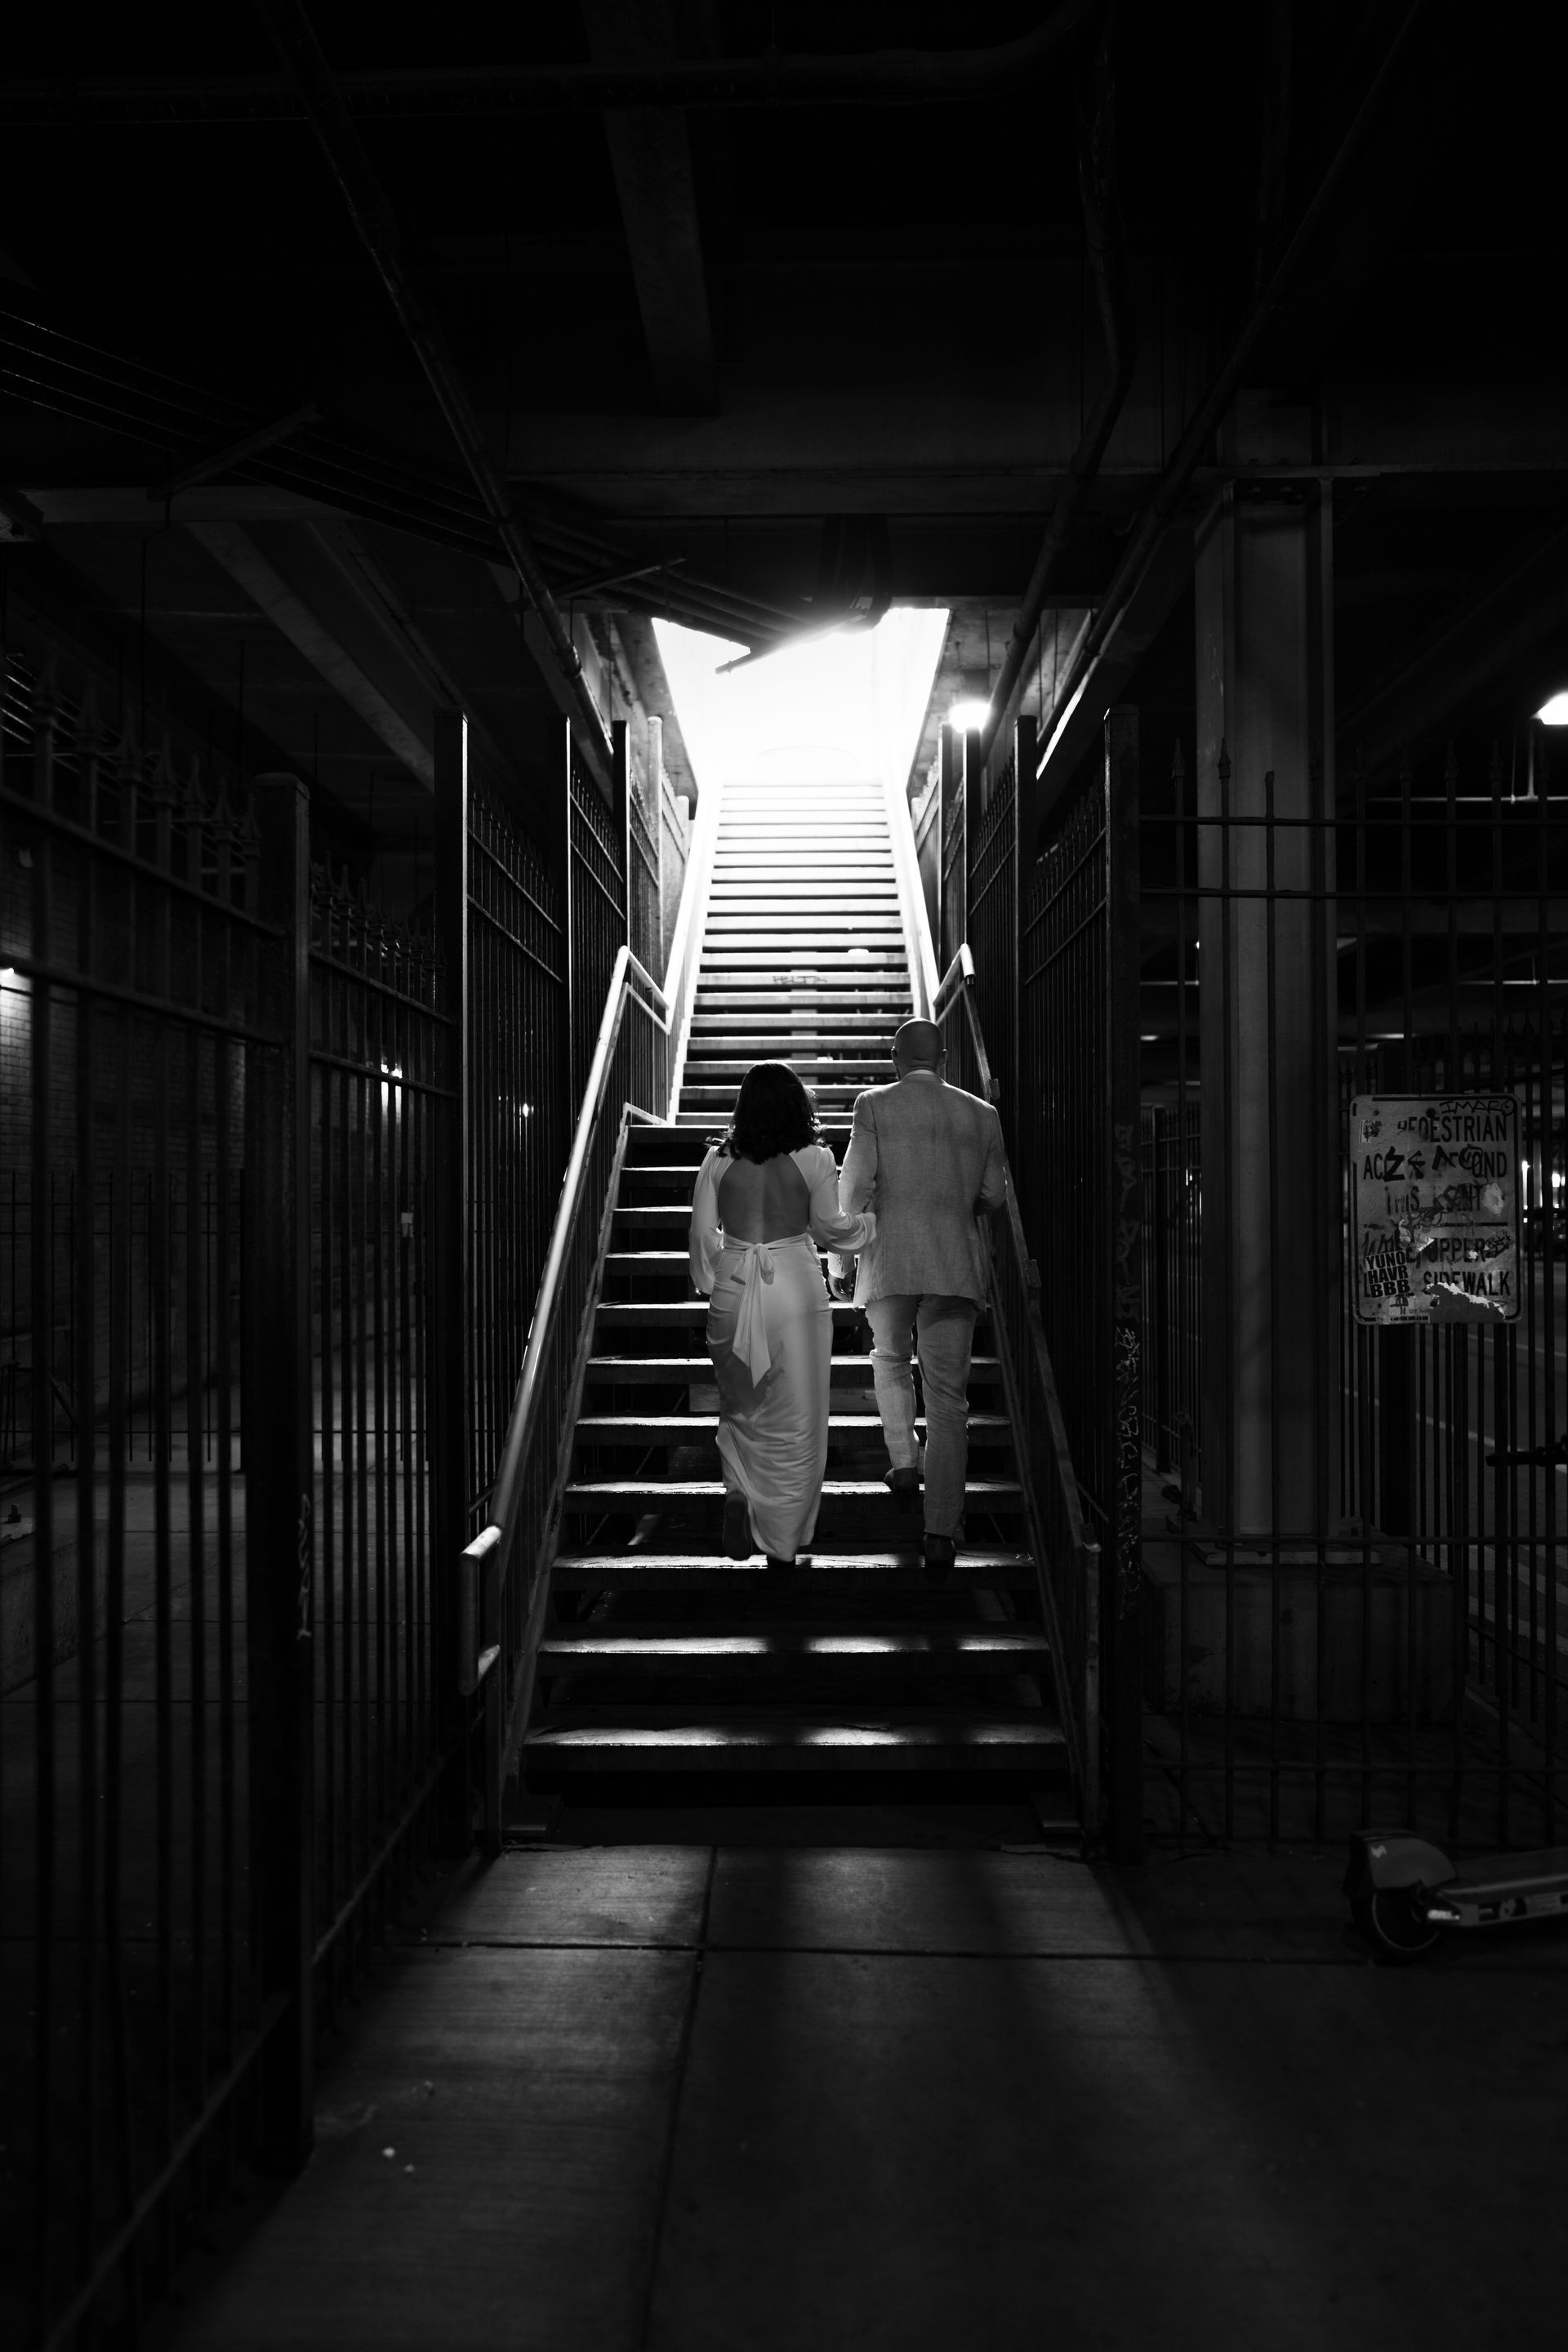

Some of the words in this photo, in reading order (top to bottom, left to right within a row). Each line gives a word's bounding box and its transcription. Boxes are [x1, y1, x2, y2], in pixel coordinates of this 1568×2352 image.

[1365, 1250, 1406, 1270] YUNO
[1370, 1279, 1411, 1298] BBB
[1422, 1271, 1512, 1297] SIDEWALK
